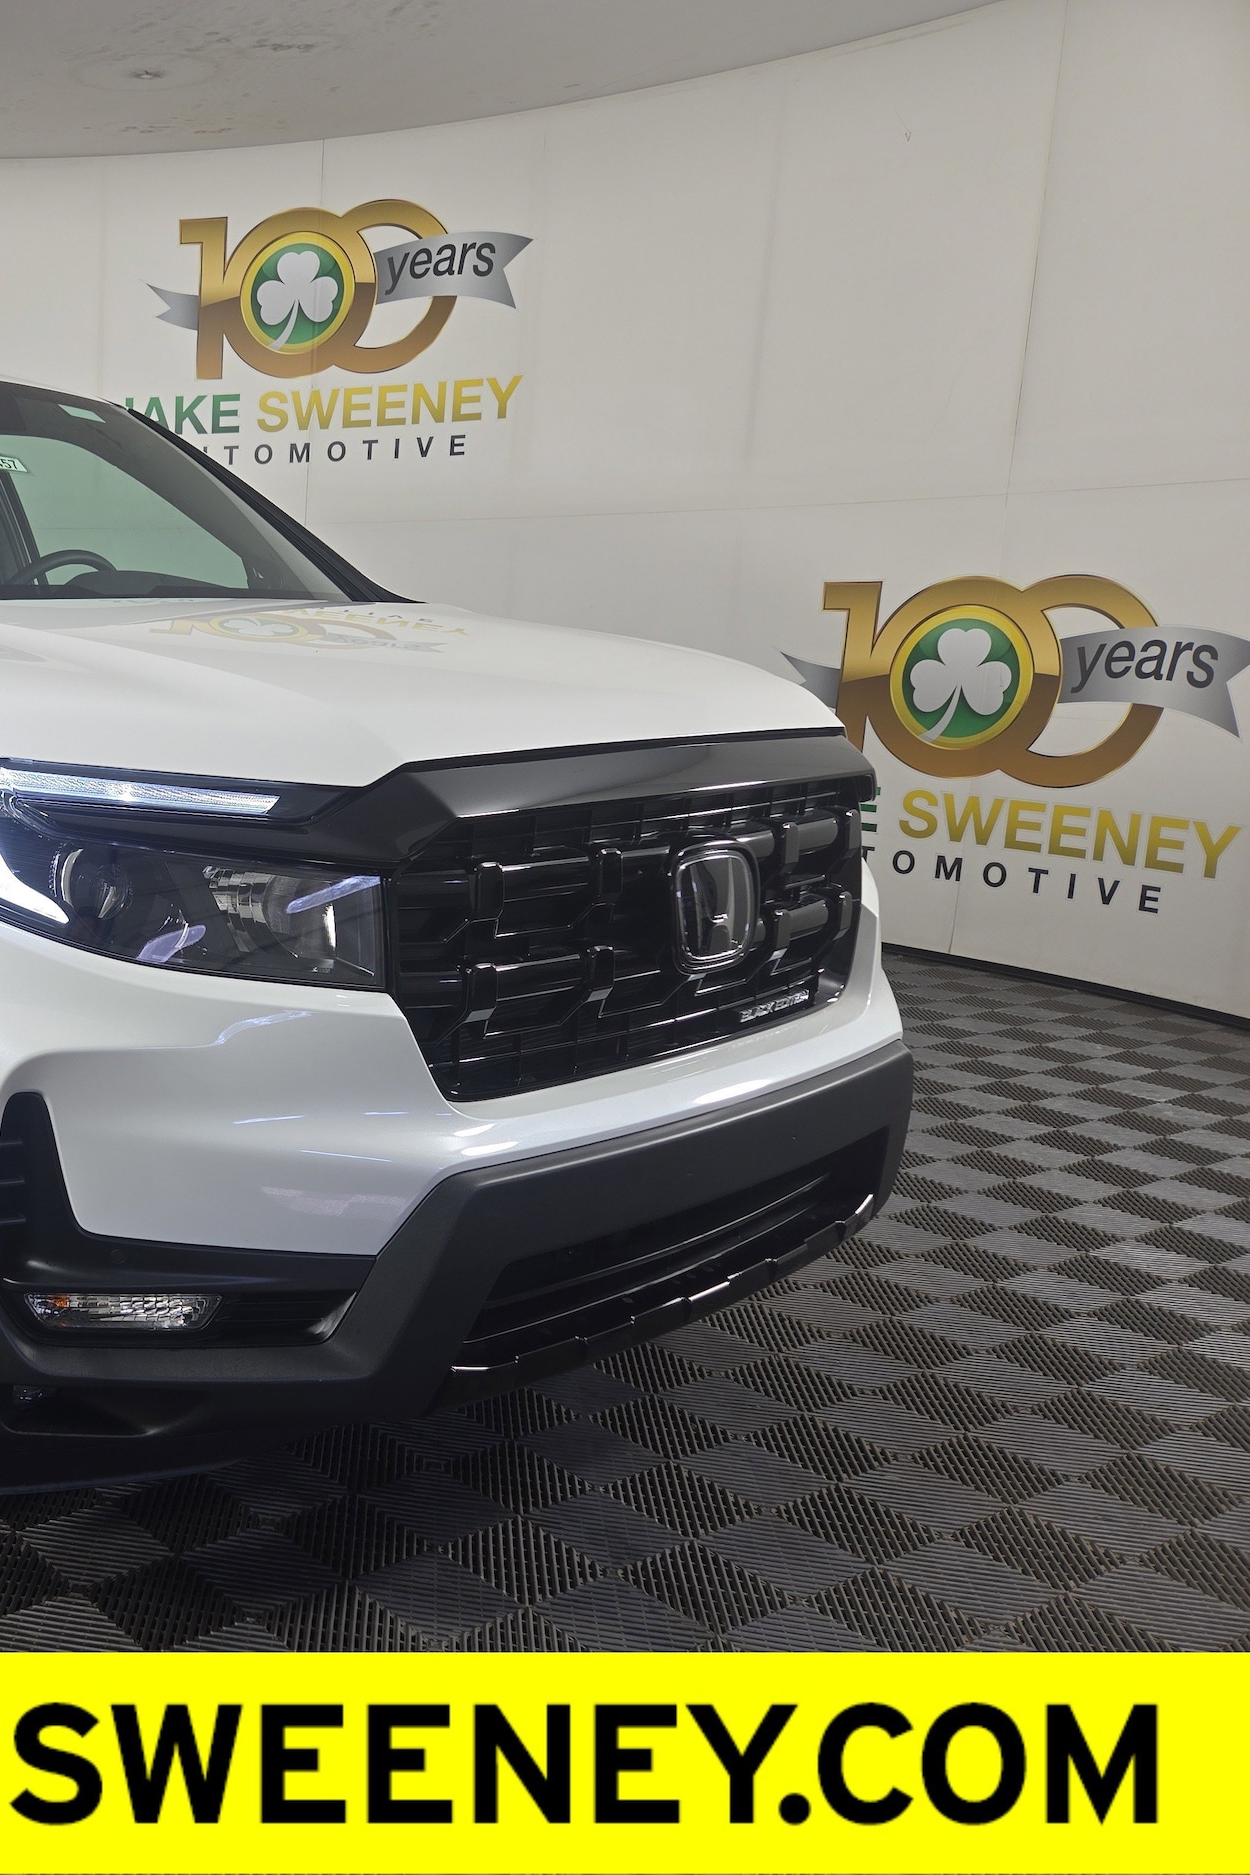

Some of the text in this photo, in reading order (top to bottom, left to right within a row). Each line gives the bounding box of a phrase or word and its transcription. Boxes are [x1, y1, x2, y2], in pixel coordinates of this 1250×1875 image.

[384, 240, 496, 296] years
[257, 374, 524, 433] SWEENEY
[203, 434, 467, 466] TOMOTIVE
[1070, 638, 1219, 690] years
[899, 789, 1242, 879] SWEENEY
[862, 845, 1162, 914] TOMOTIVE
